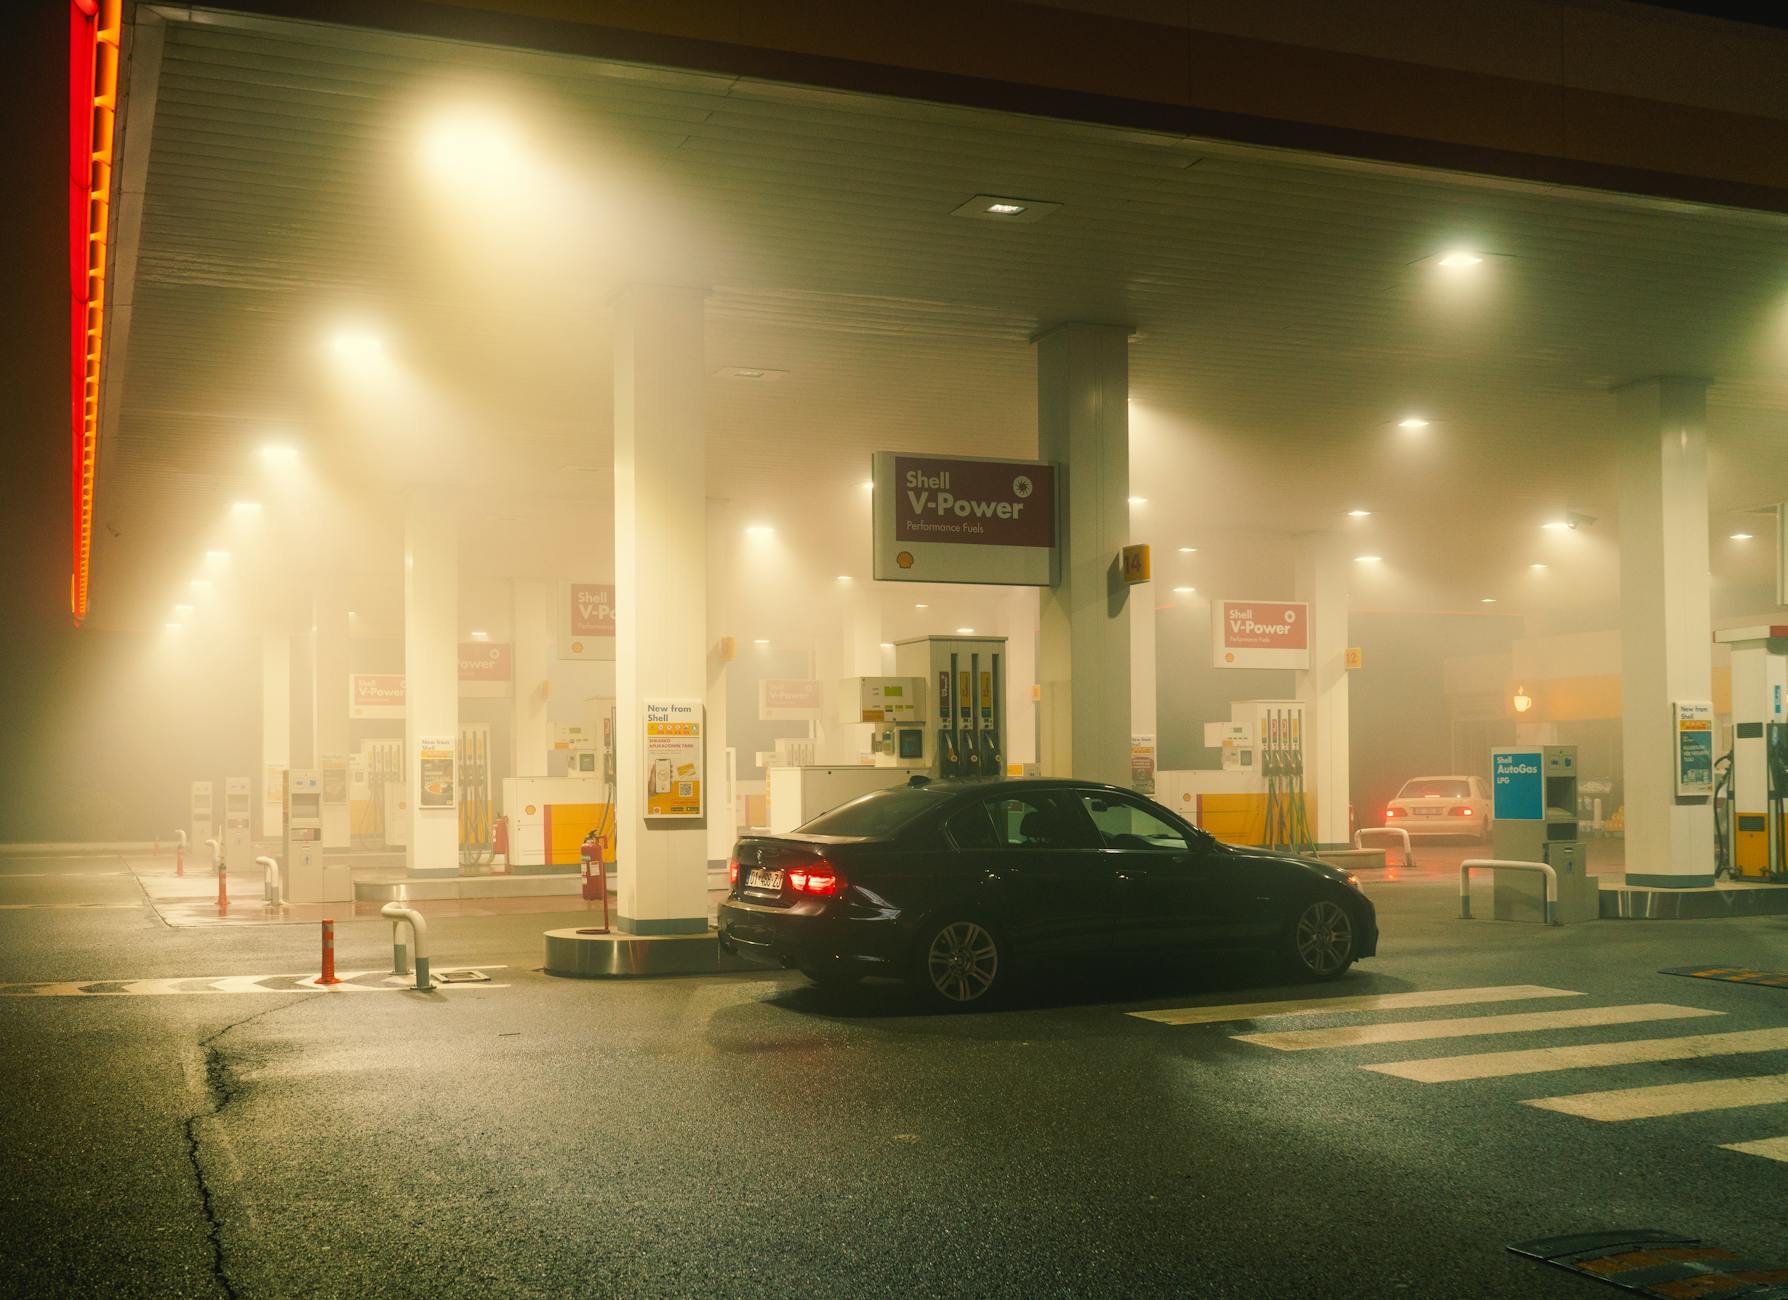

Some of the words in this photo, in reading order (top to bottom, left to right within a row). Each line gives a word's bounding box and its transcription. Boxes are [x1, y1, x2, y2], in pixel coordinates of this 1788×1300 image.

[906, 470, 950, 490] Shell
[906, 491, 1024, 520] V-Power
[906, 520, 960, 533] Performance
[963, 521, 984, 534] Fuels
[1124, 554, 1142, 571] 14
[577, 591, 608, 603] Shell
[1229, 609, 1253, 620] Shell
[1230, 620, 1291, 635] V-Power
[647, 704, 669, 712] New
[671, 704, 692, 712] from
[647, 714, 669, 722] Shell
[1497, 755, 1513, 764] Shell
[1497, 764, 1538, 774] AutoGas
